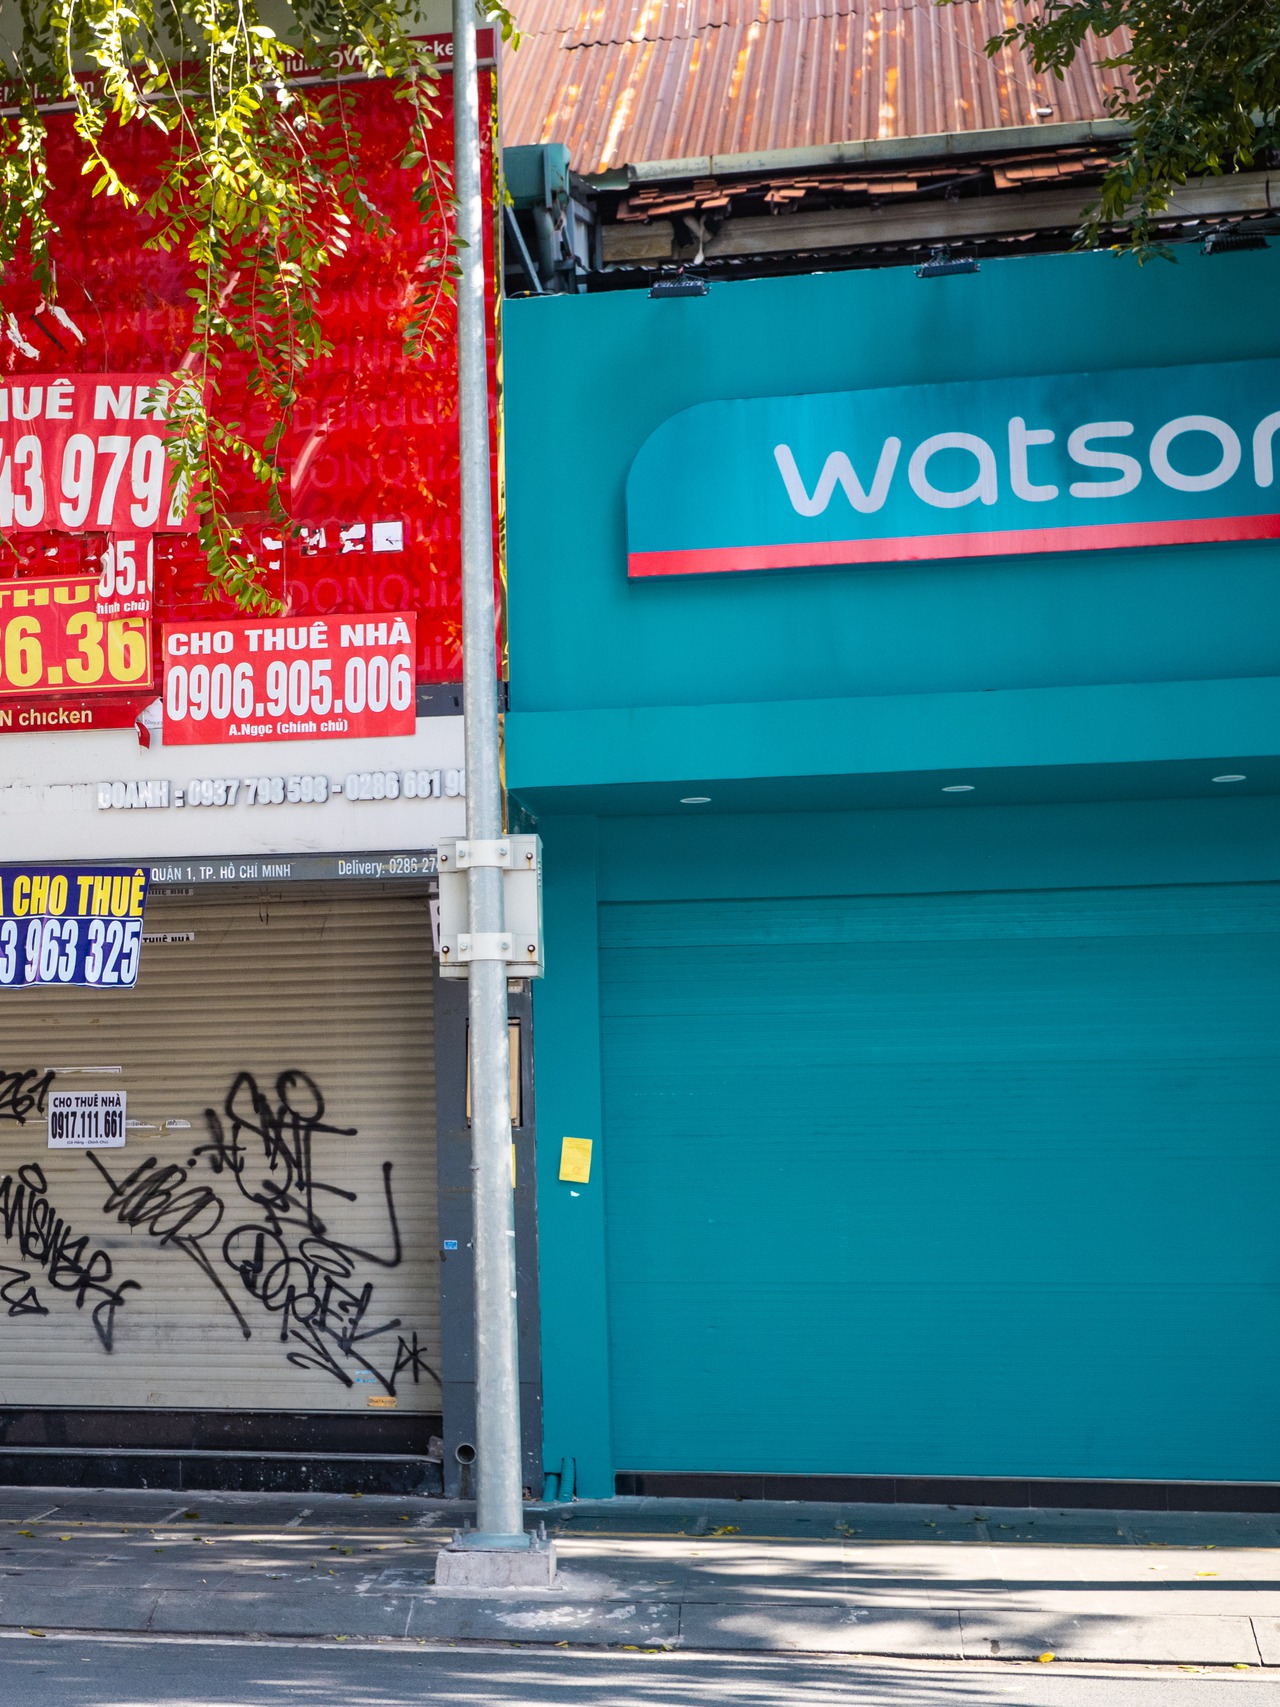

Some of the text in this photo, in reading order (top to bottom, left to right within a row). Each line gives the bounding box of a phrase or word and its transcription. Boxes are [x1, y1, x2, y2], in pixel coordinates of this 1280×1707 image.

[96, 601, 120, 614] hính
[167, 617, 412, 655] CHO THUÊ NHÀ
[166, 654, 412, 721] 0906.905.006
[18, 707, 93, 727] chicken
[228, 718, 348, 738] A.Ngọc (chính chủ)
[97, 780, 170, 810] DOANH
[187, 778, 240, 807] 0937
[345, 771, 400, 801] 0286
[151, 865, 182, 882] QUẬN
[199, 866, 216, 880] TP.
[220, 861, 235, 879] HỒ
[239, 862, 258, 878] CHÍ
[262, 863, 291, 877] MINH
[338, 859, 385, 878] Delivery:
[389, 858, 417, 874] 0286
[422, 857, 438, 873] 27
[12, 874, 69, 917] CHO
[77, 868, 145, 917] THUÊ
[24, 918, 79, 983] 963
[84, 919, 141, 984] 325
[53, 1093, 122, 1108] CHO THUÊ NHÀ
[51, 1110, 123, 1139] 0917.111.661
